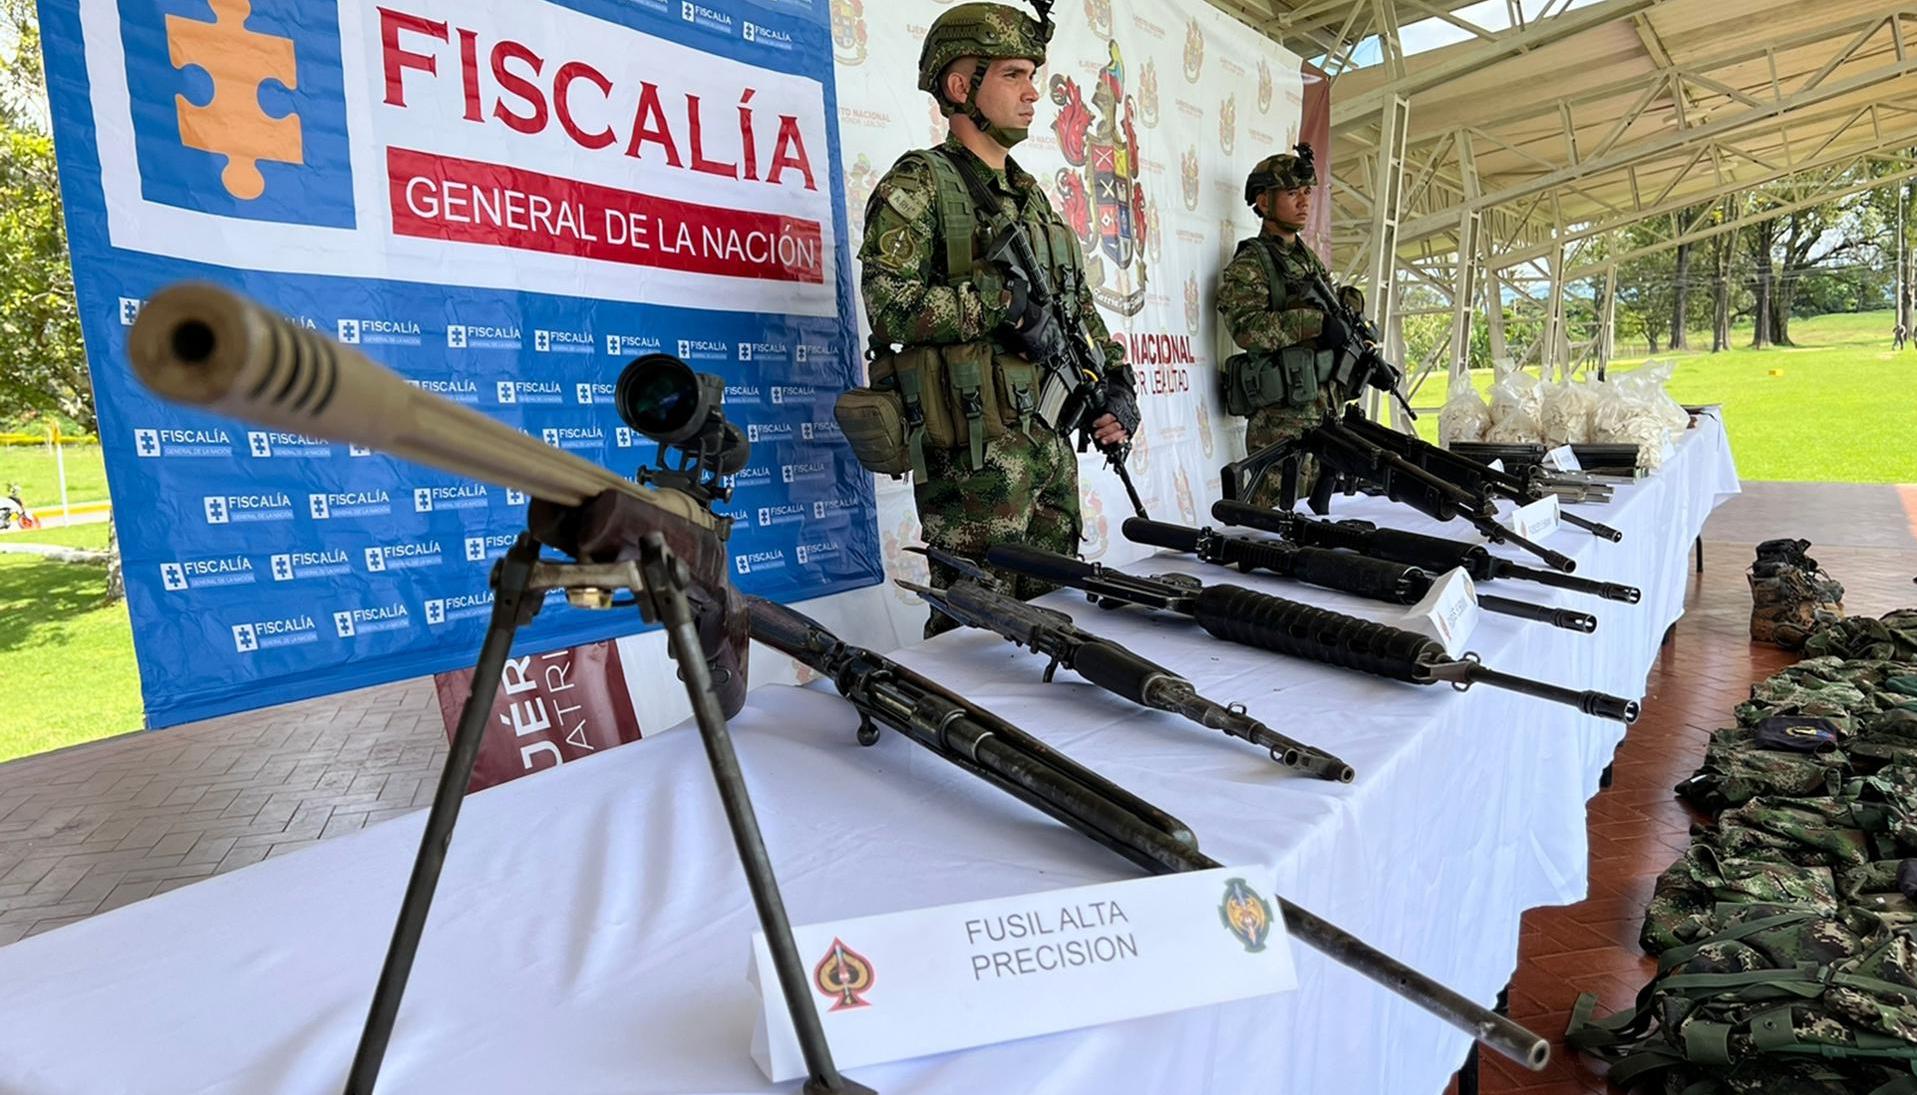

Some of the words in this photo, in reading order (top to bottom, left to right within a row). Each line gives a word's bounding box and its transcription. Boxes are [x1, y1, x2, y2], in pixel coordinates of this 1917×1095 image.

[694, 6, 732, 25] FISCALÍA
[754, 25, 792, 42] FISCALÍA
[376, 6, 818, 192] FISCALÍA
[405, 175, 598, 242] GENERAL
[605, 208, 650, 250] DE
[658, 217, 697, 257] LA
[702, 224, 815, 270] NACIÓN
[361, 319, 420, 334] FISCALÍA
[467, 325, 521, 340] FISCALÍA
[550, 331, 594, 344] FISCALÍA
[621, 335, 661, 347] FISCALÍA
[690, 339, 728, 352] FISCALÍA
[1129, 333, 1195, 365] NACIONAL
[421, 379, 478, 392] FISCALÍA
[516, 380, 562, 393] FISCALÍA
[160, 428, 230, 443] FISCALÍA
[559, 427, 603, 438] FISCALÍA
[228, 491, 292, 509] FISCALÍA
[328, 488, 390, 505] FISCALÍA
[432, 484, 488, 499] FISCALÍA
[292, 548, 348, 566] FISCALÍA
[384, 540, 442, 557] FISCALÍA
[184, 555, 253, 575] FISCALÍA
[446, 592, 495, 609] FISCALÍA
[354, 604, 408, 622] FISCALÍA
[255, 614, 316, 635] FISCALÍA
[965, 912, 1054, 945] FUSIL
[1059, 900, 1129, 929] ALTA
[971, 933, 1140, 981] PRECISION
